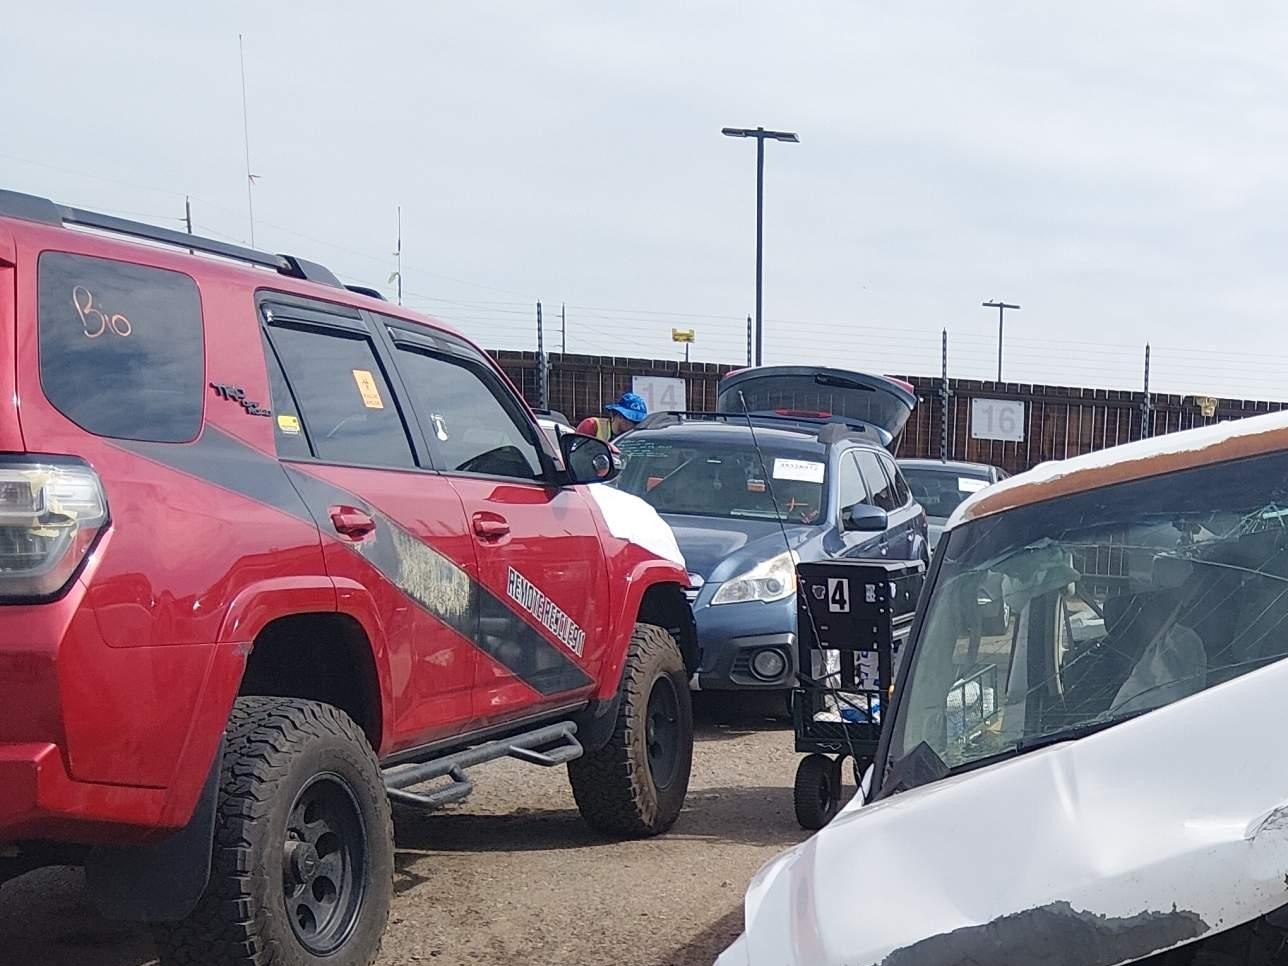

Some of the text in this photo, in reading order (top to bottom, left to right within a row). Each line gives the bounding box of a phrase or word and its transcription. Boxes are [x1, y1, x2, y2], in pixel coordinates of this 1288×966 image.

[73, 285, 132, 338] Bio
[642, 383, 678, 413] 14
[982, 404, 1016, 434] 16
[507, 567, 545, 622] REMOTE
[831, 580, 847, 611] 4
